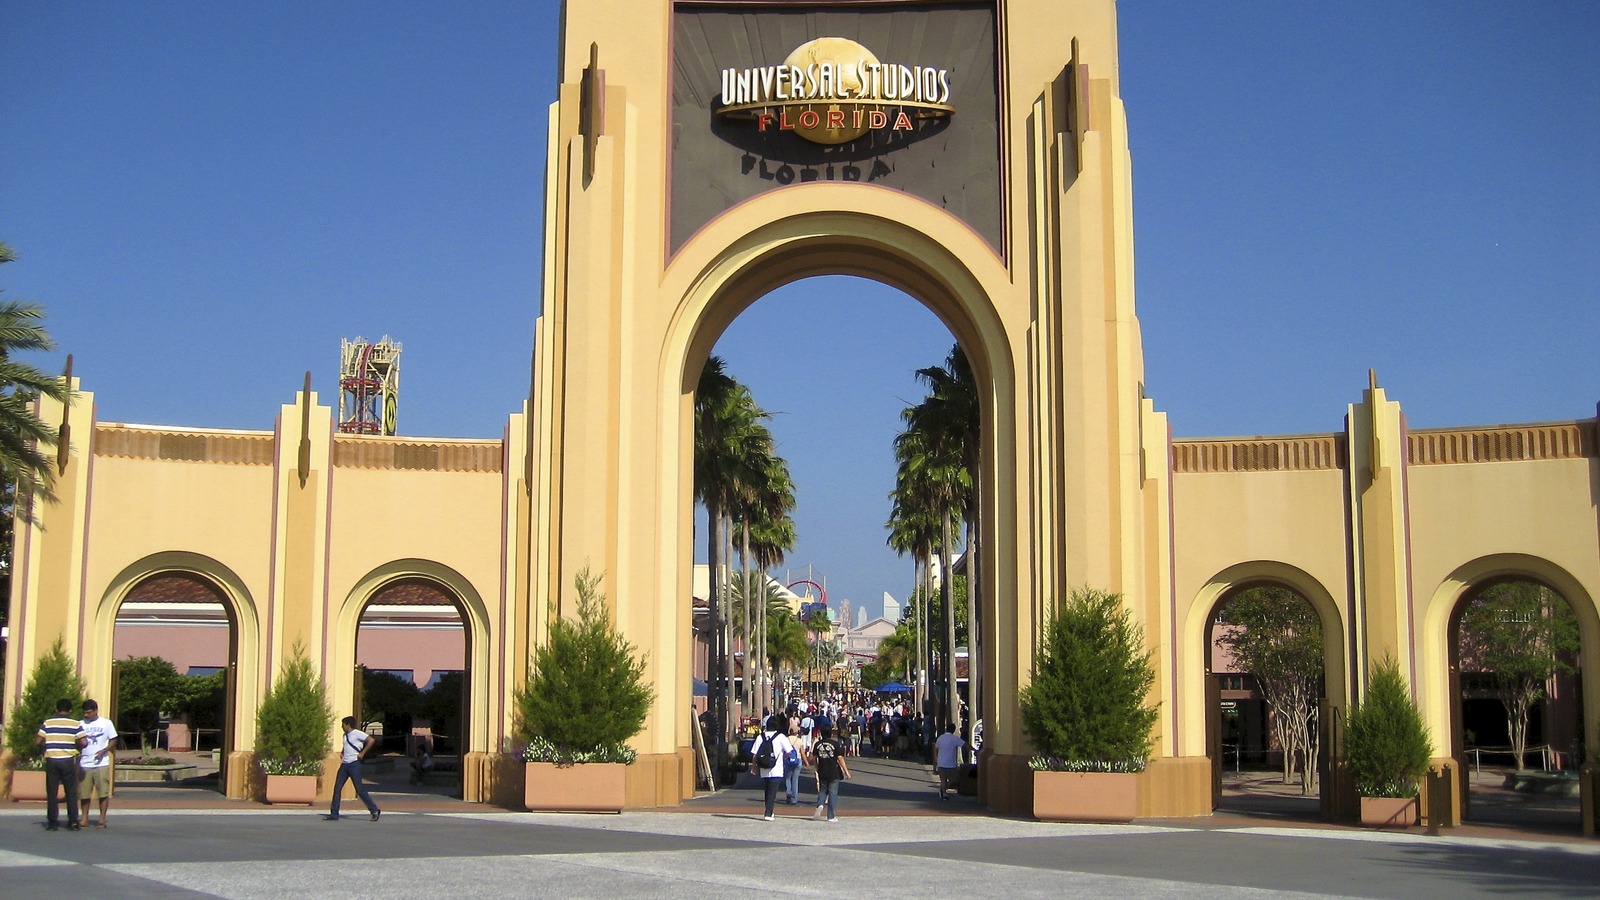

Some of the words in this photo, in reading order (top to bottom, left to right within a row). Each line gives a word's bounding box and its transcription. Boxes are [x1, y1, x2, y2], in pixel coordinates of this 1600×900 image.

[721, 62, 848, 105] UNIVERSAL
[857, 59, 950, 103] STUDIOS
[758, 110, 913, 131] FLORIDA
